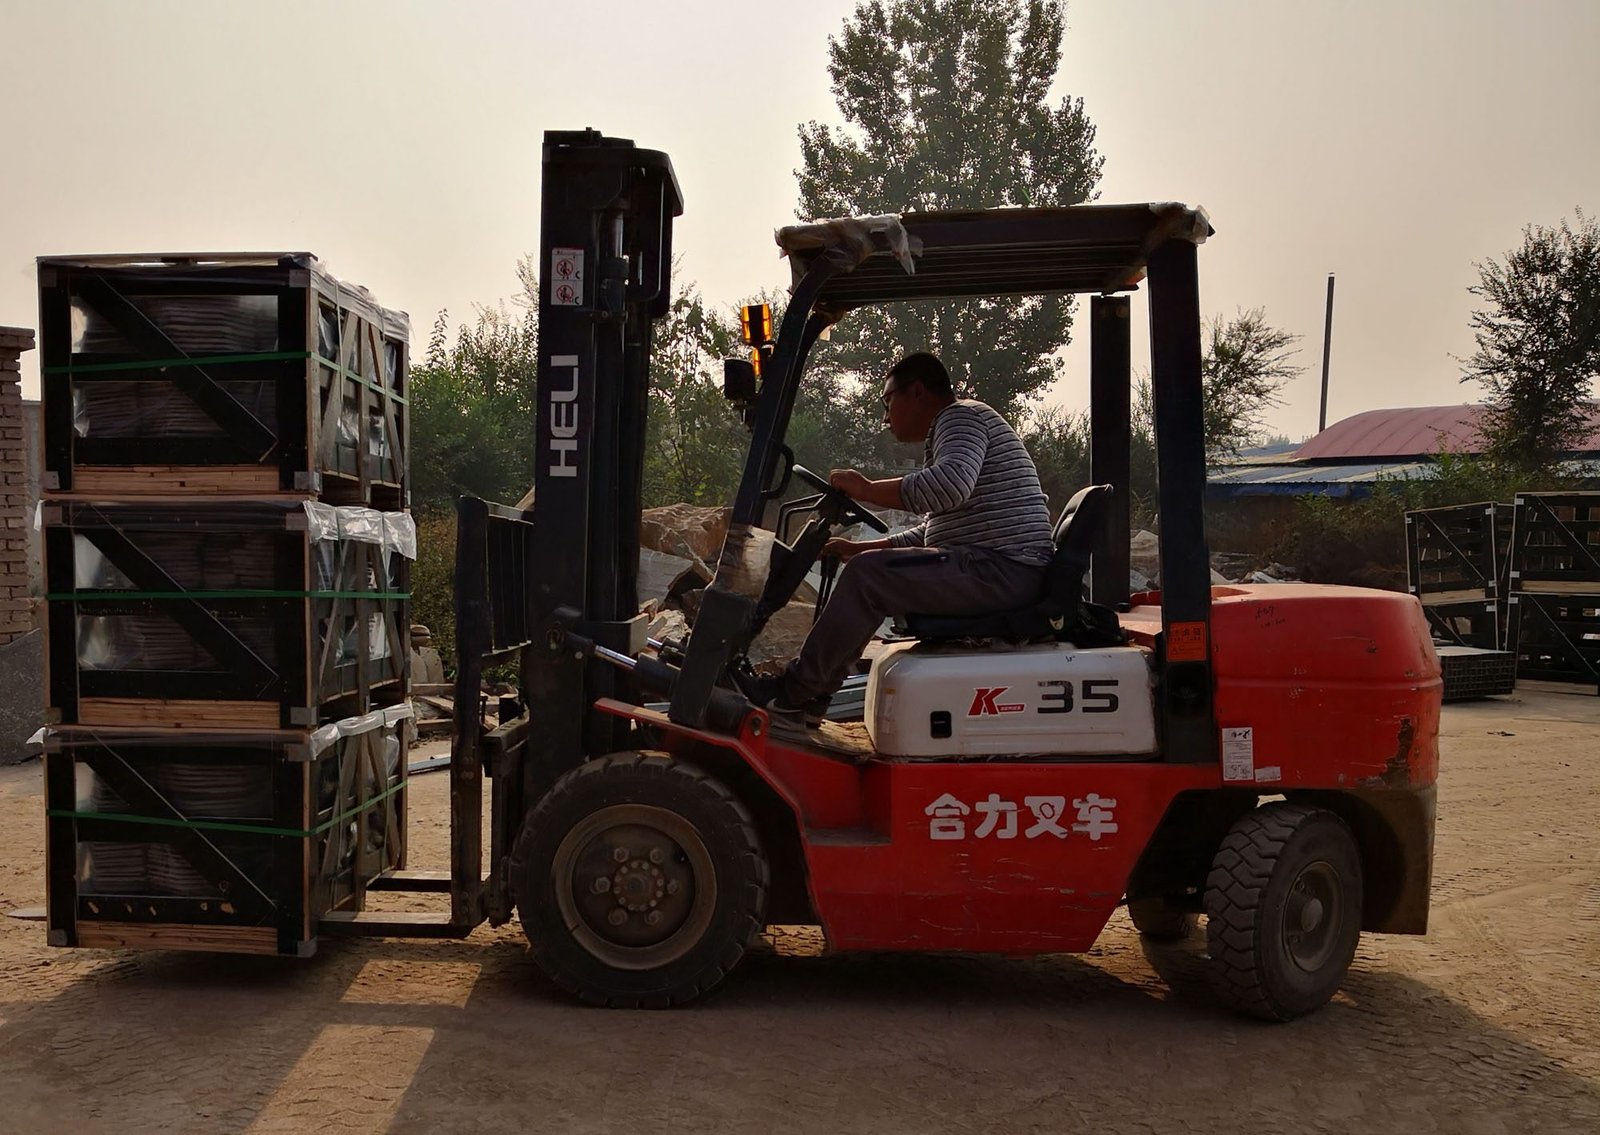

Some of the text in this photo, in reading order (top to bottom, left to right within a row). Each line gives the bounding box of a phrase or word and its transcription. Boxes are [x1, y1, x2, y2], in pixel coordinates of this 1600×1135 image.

[549, 354, 579, 477] HELI
[968, 680, 1119, 716] K 35
[924, 793, 1119, 840] 合力叉车
